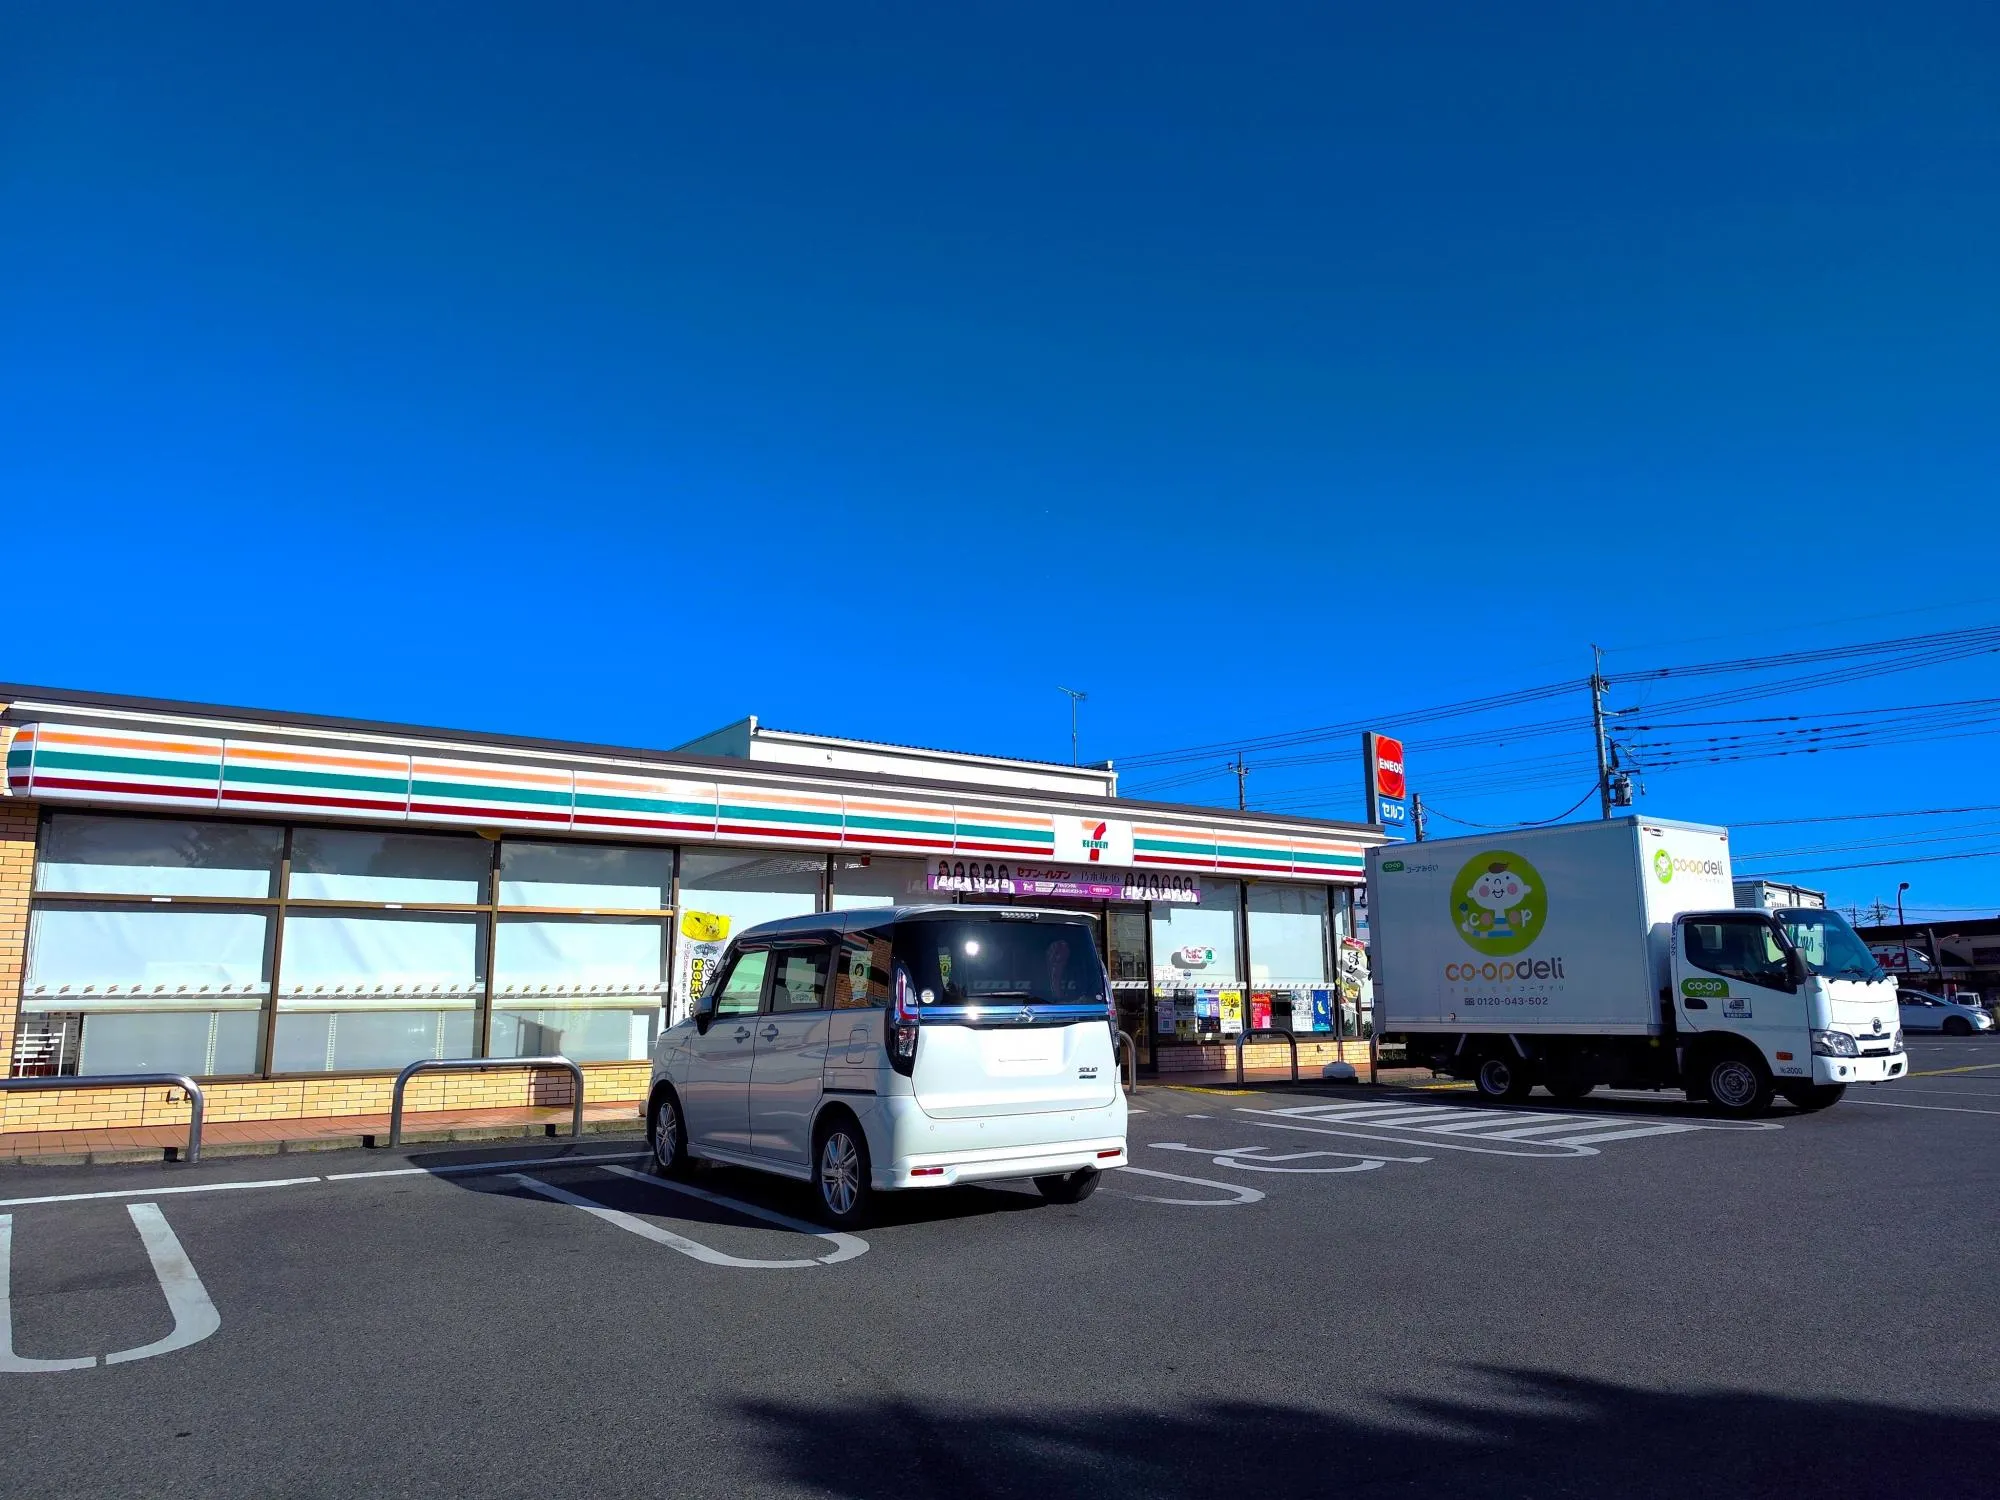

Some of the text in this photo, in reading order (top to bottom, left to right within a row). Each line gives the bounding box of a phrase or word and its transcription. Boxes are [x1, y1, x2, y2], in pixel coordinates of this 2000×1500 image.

[1379, 757, 1403, 775] ENEOS
[1381, 802, 1405, 820] セルフ
[1445, 956, 1565, 983] co-opdeli
[1687, 982, 1722, 992] co-op
[1477, 996, 1549, 1006] 0120-043-502
